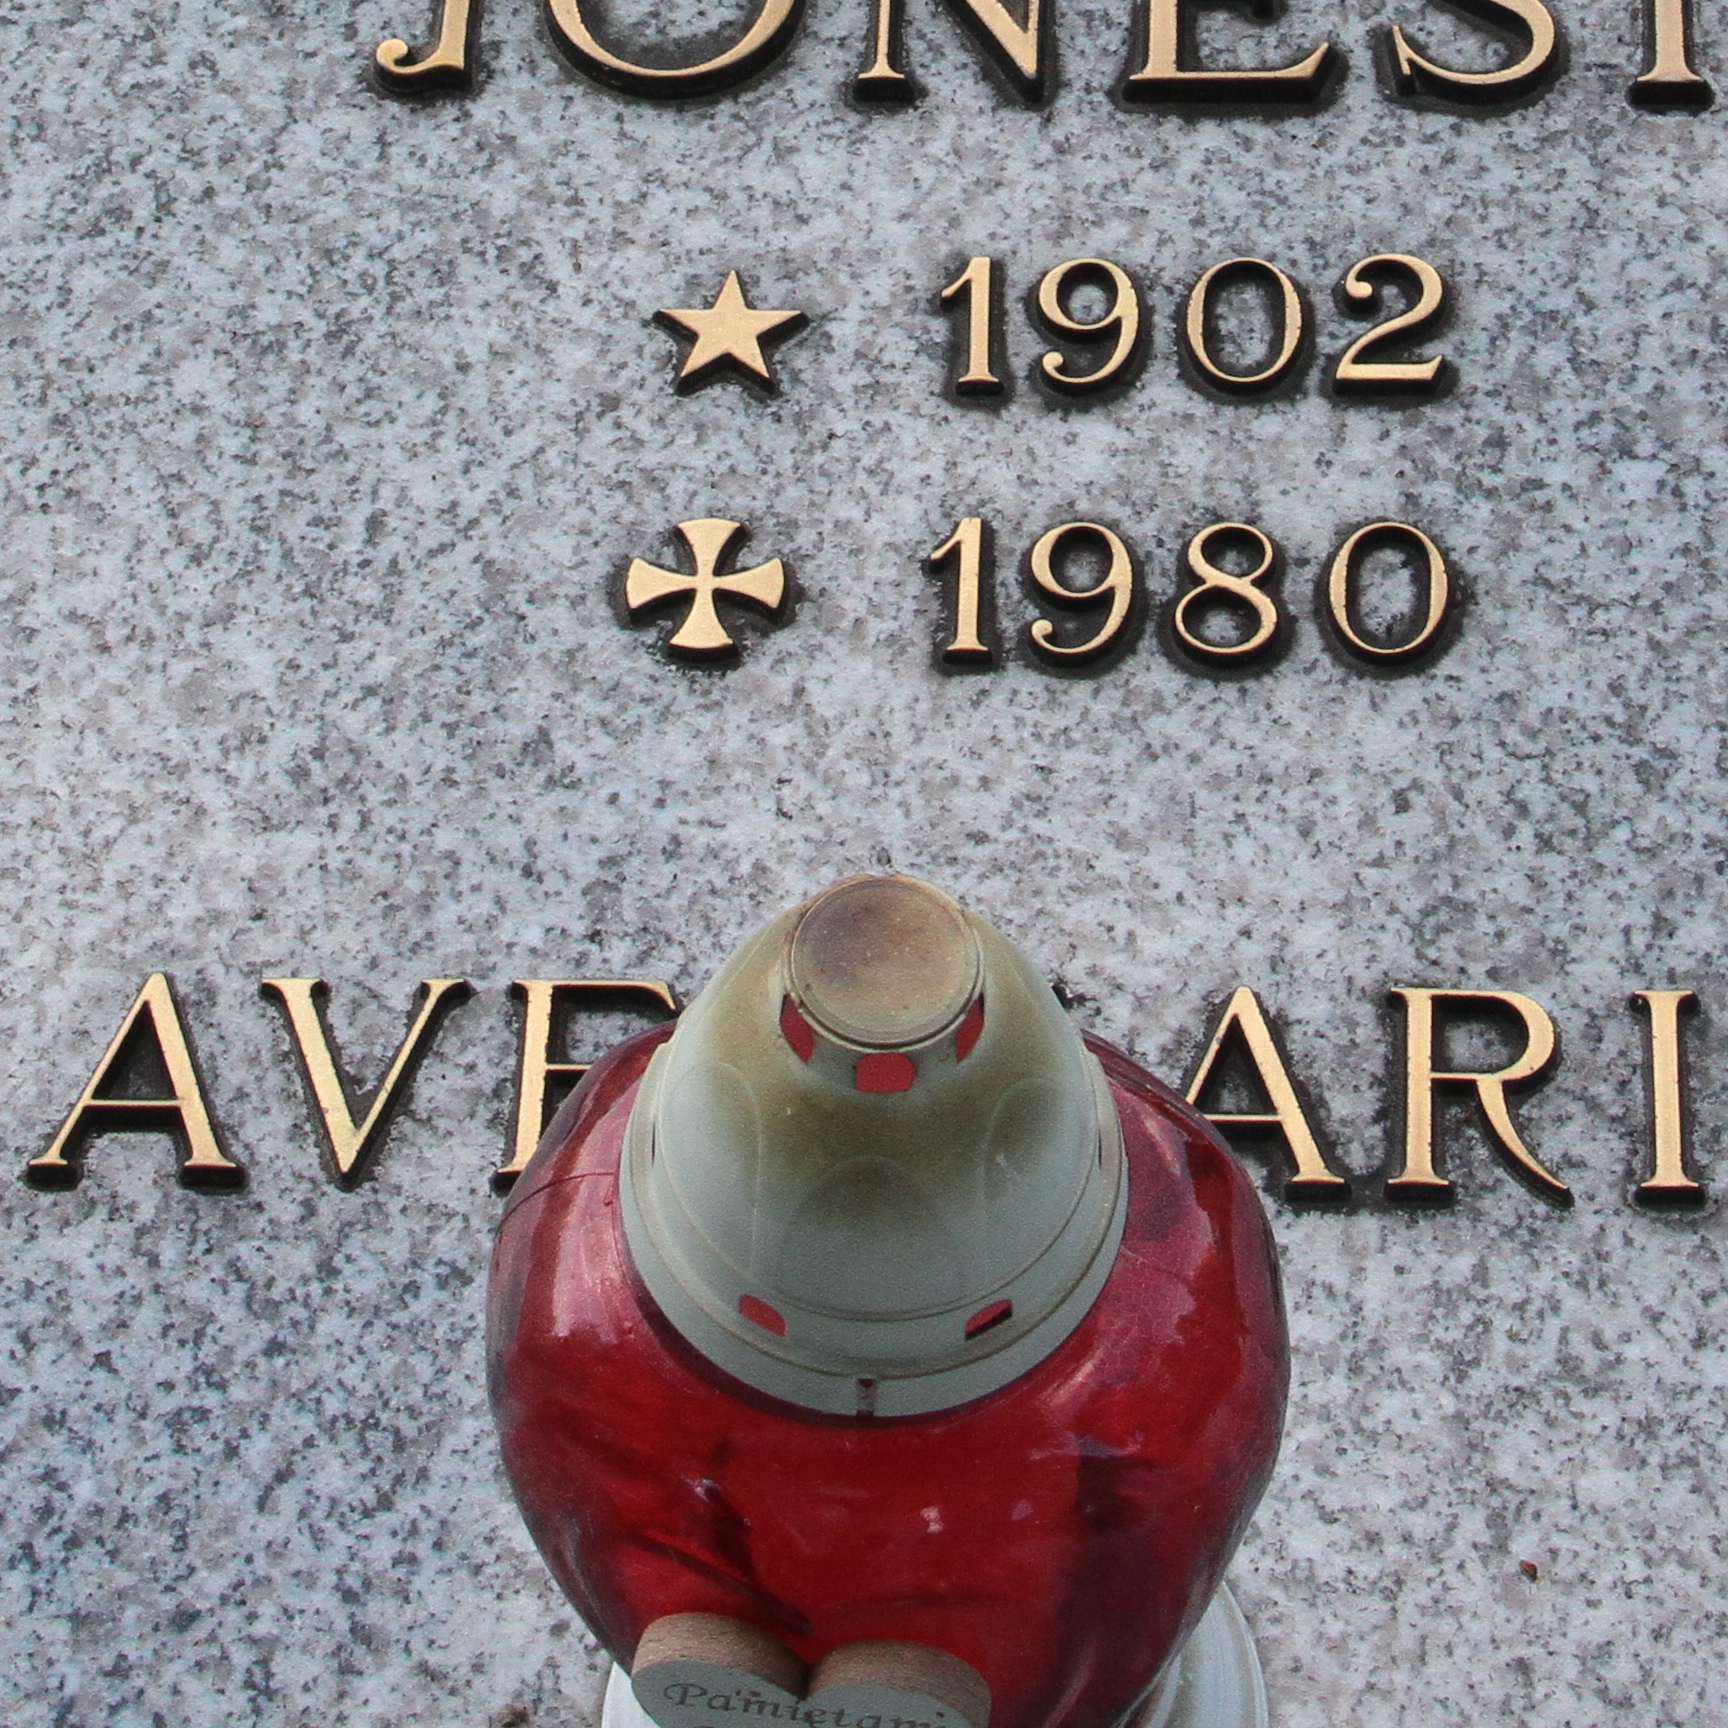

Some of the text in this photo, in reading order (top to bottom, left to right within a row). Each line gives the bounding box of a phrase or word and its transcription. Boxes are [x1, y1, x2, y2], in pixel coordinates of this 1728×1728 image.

[939, 253, 1450, 398] 1902
[926, 515, 1459, 666] 1980
[23, 970, 679, 1192] AVE
